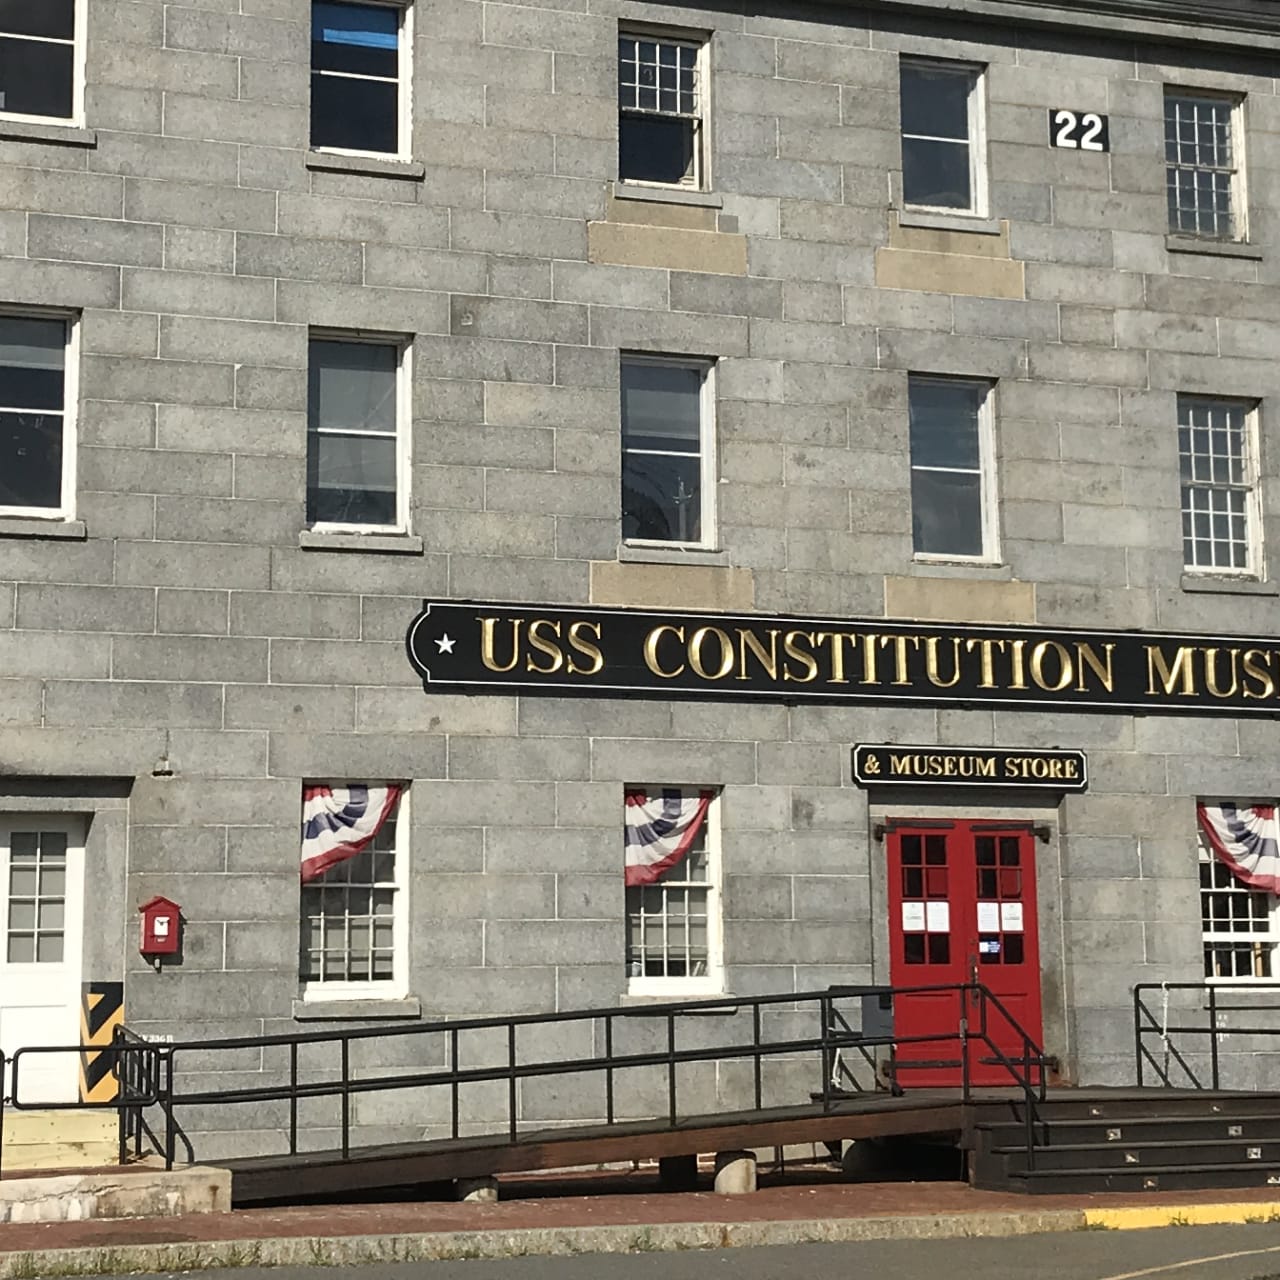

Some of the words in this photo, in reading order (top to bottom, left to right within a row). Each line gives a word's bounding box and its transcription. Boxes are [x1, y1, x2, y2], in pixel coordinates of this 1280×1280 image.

[1055, 110, 1104, 151] 22
[476, 617, 605, 676] USS
[643, 620, 1116, 693] CONSTITUTION
[864, 754, 881, 774] &
[889, 754, 997, 777] MUSEUM
[1005, 757, 1078, 779] STORE
